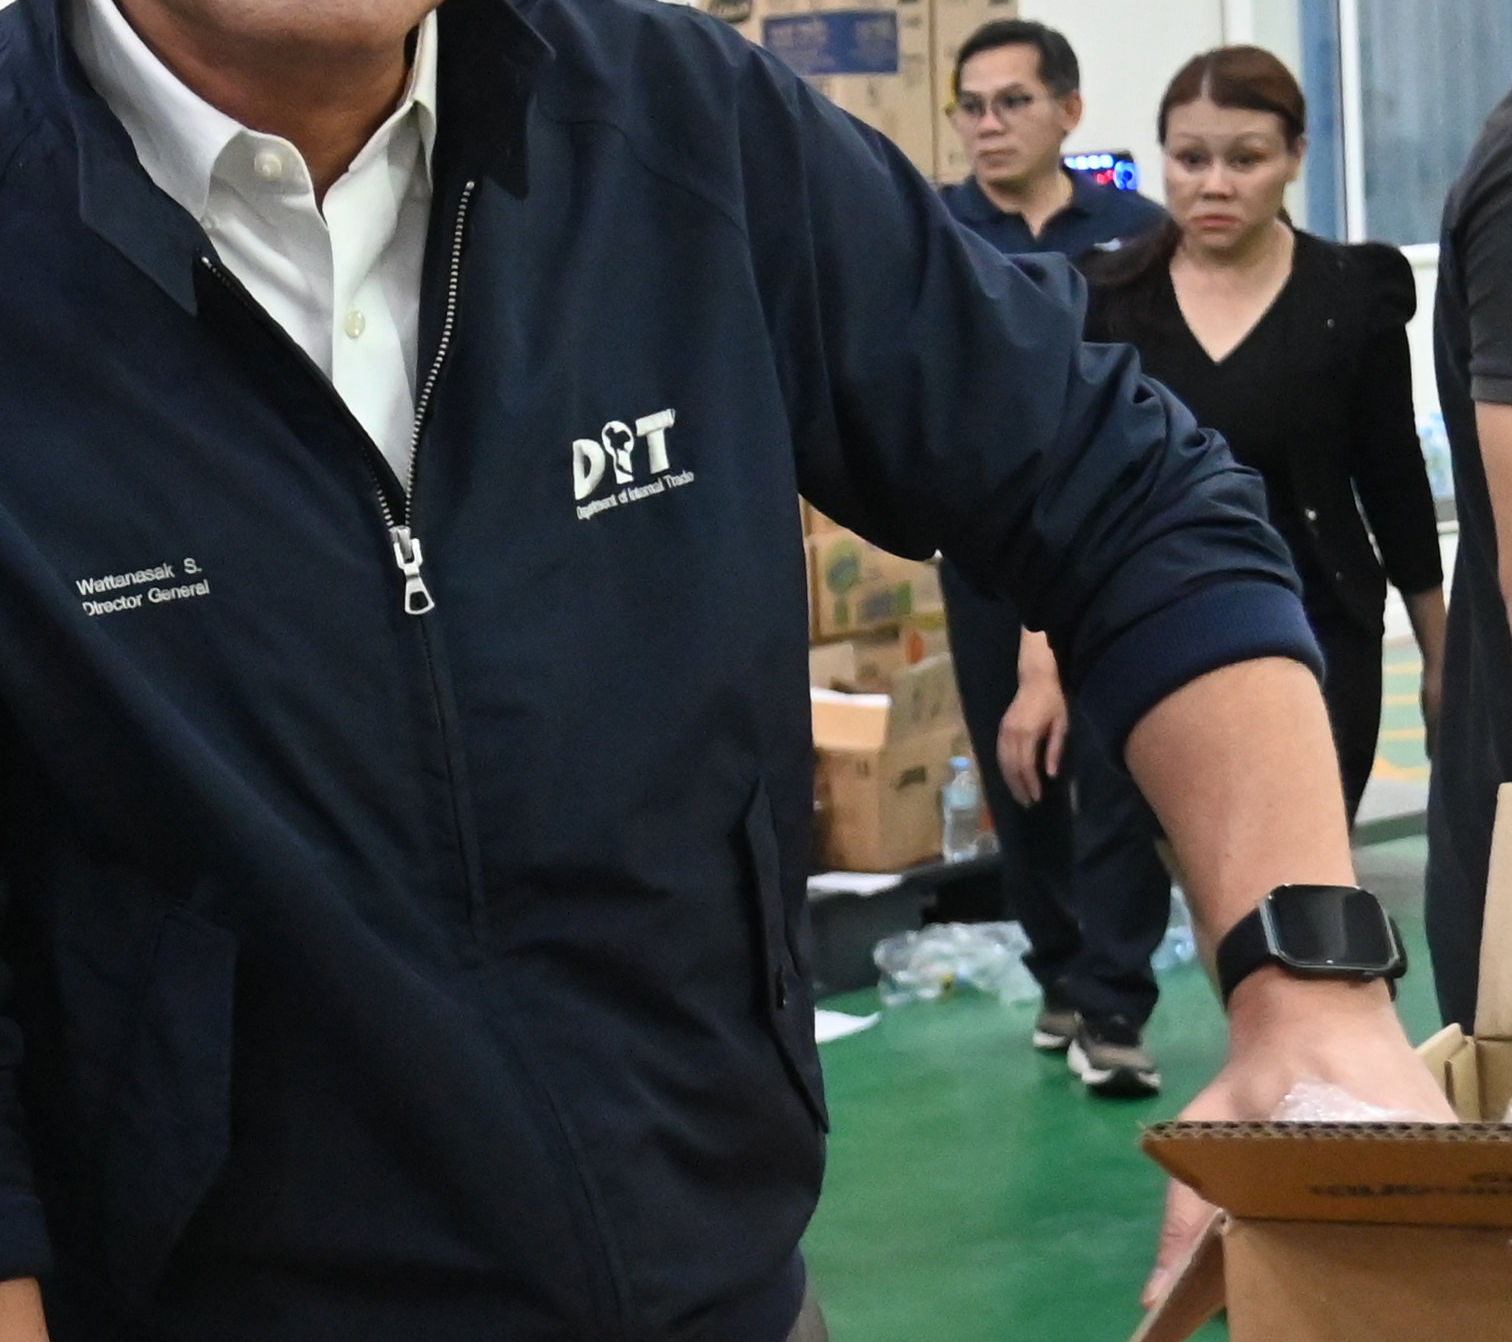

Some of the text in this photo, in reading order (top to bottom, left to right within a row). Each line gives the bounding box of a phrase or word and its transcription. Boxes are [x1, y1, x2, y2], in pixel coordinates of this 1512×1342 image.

[75, 557, 203, 596] Wattanasak S.
[81, 578, 211, 617] Director General
